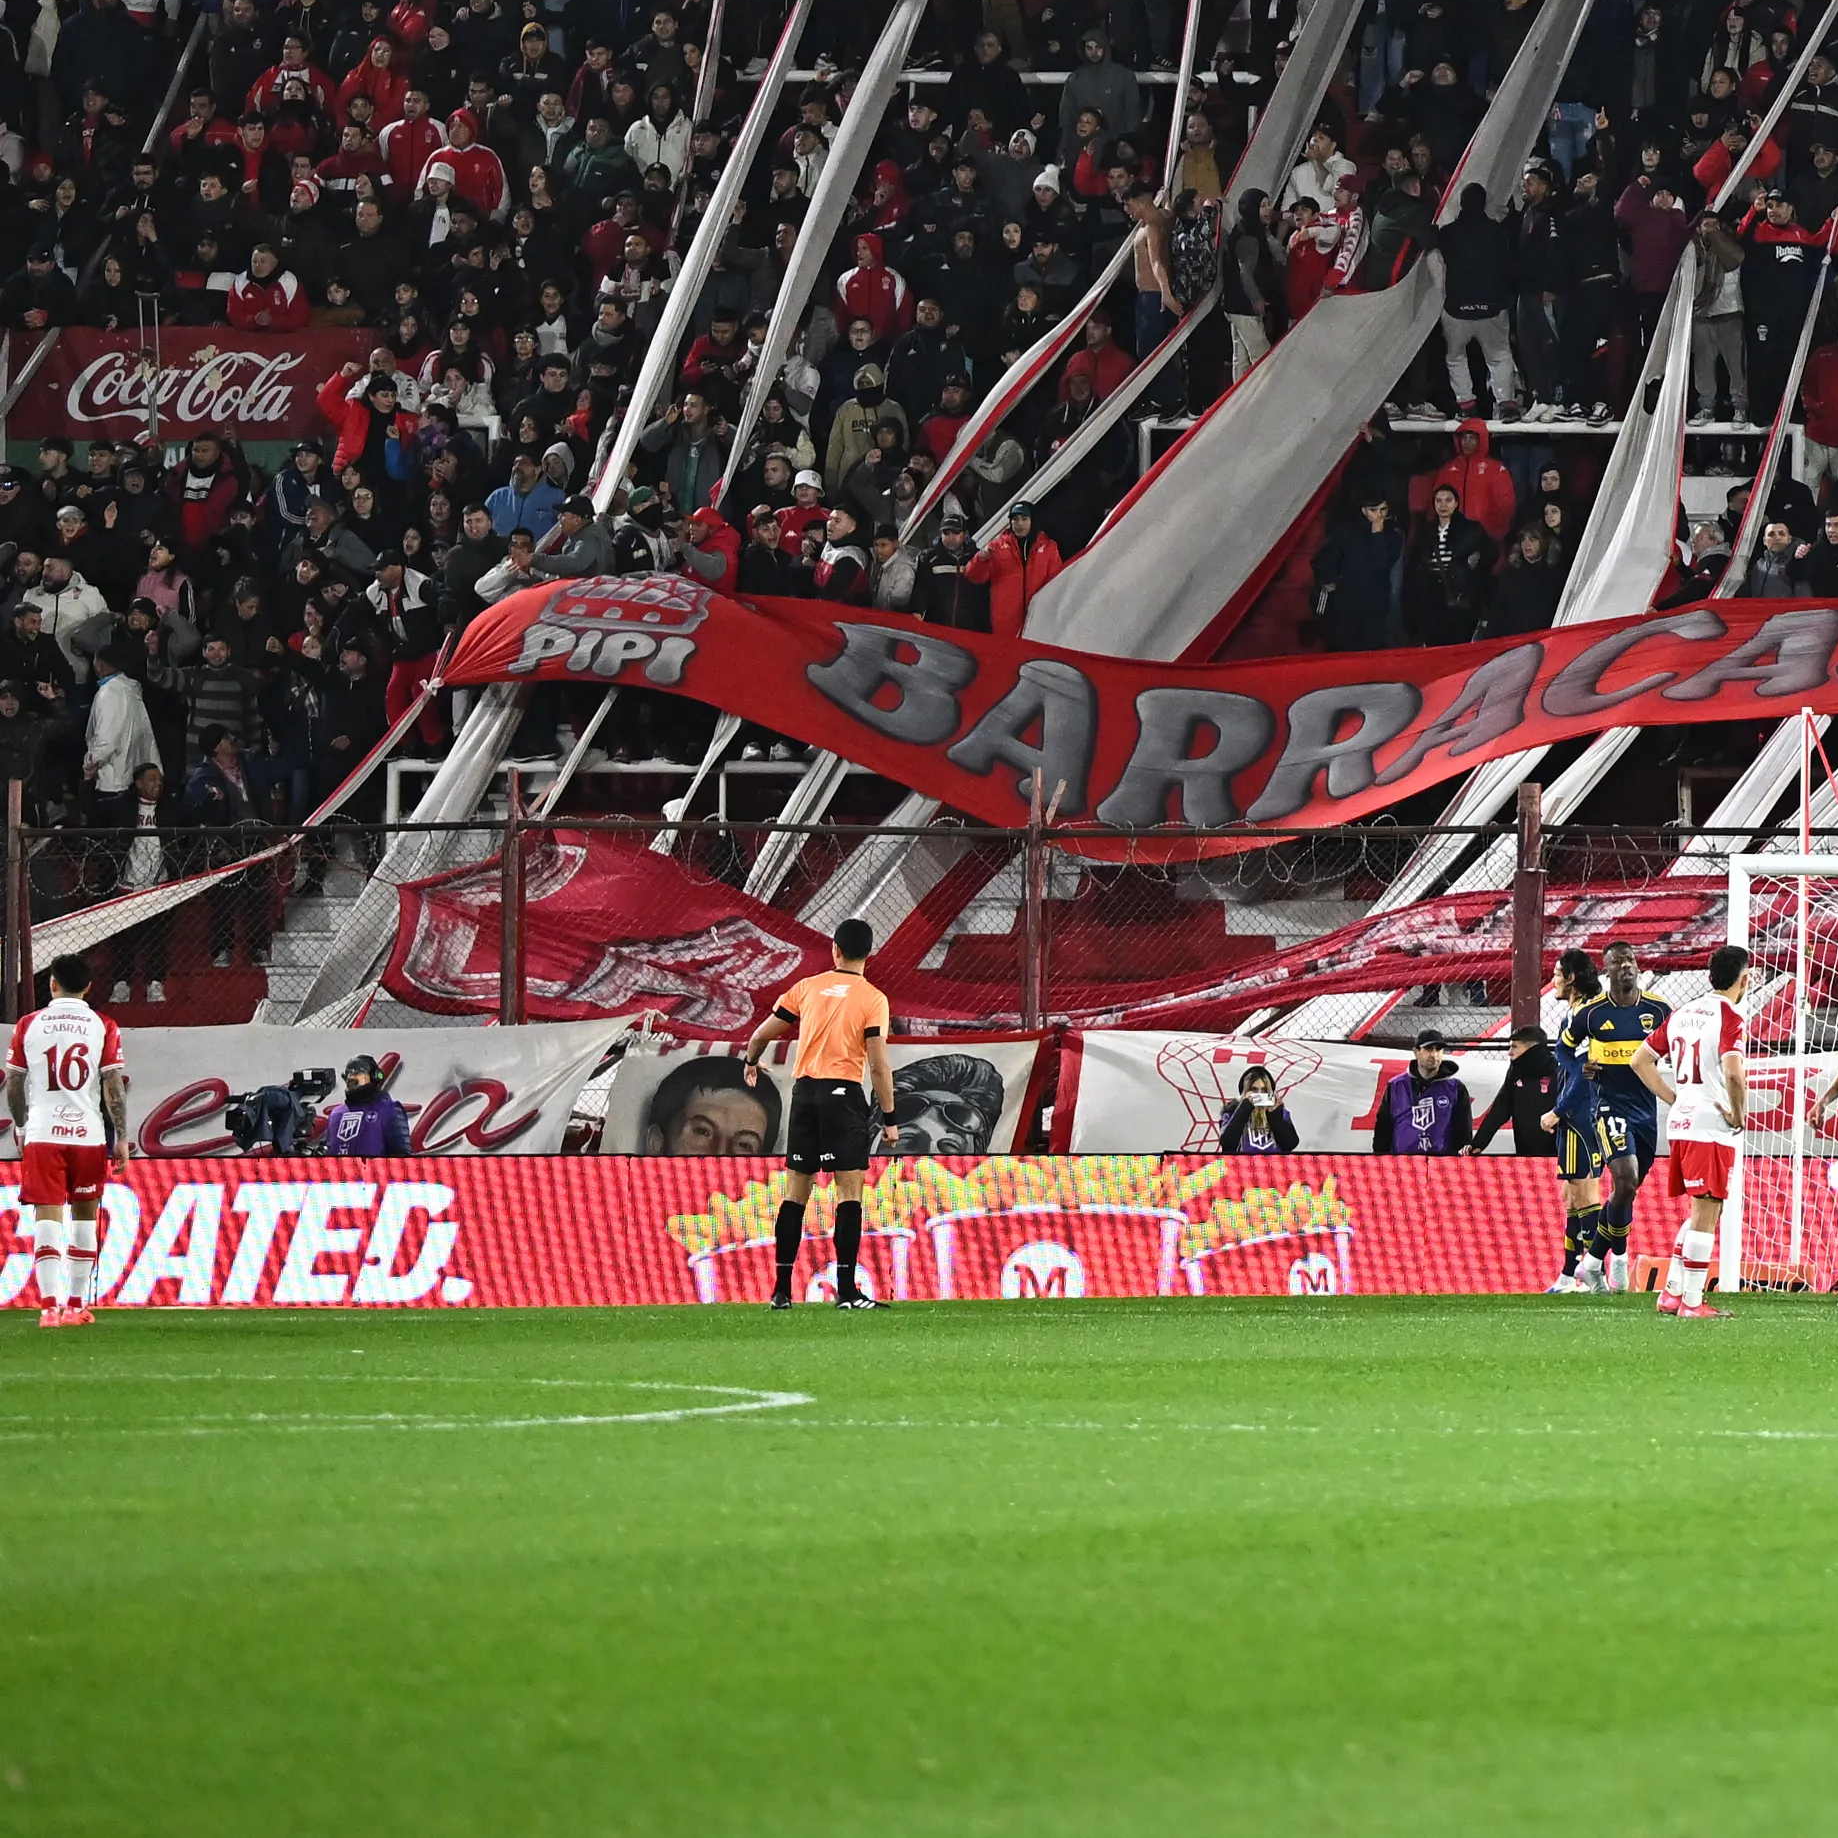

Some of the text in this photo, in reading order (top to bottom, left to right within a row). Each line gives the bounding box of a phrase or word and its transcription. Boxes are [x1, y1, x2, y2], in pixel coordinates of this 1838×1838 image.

[66, 351, 307, 423] Coca-Cola
[508, 623, 695, 687] PIPI
[41, 1013, 92, 1024] Casablanca
[43, 1023, 90, 1037] CABRAL
[42, 1042, 90, 1093] 16
[1671, 1035, 1704, 1086] 21
[1606, 1116, 1628, 1138] 17
[819, 1152, 837, 1162] TCL
